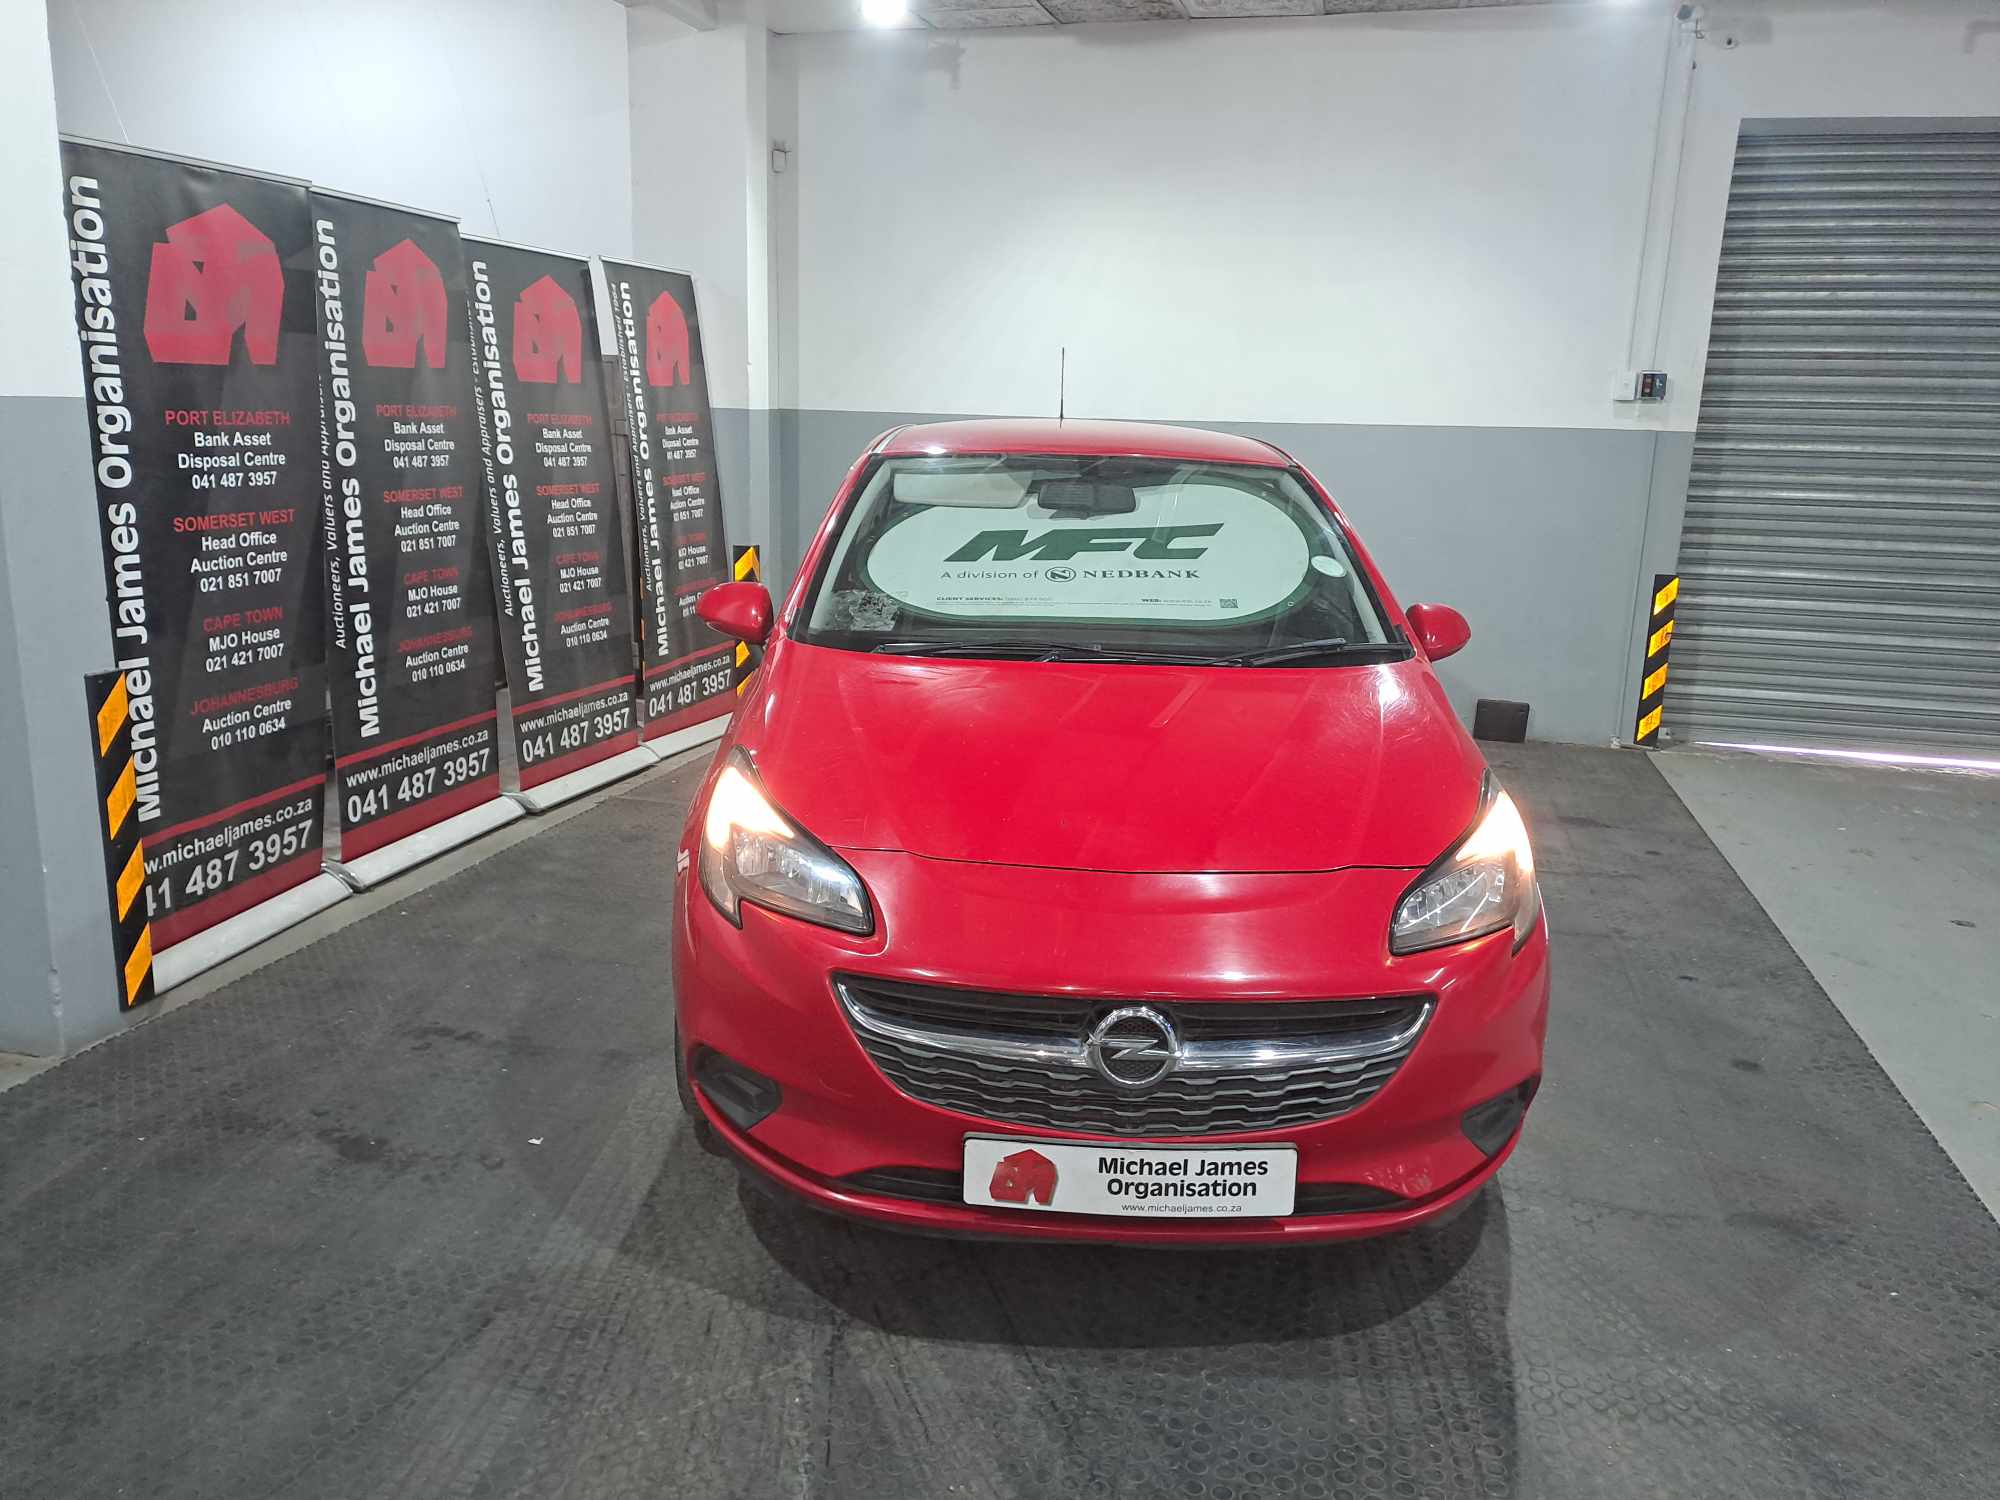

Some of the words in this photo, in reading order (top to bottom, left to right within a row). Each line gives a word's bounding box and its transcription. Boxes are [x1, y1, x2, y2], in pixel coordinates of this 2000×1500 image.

[69, 175, 132, 489] Organisation
[316, 218, 357, 467] Organisation
[472, 261, 514, 465] Organisation
[620, 282, 650, 460] Organisation
[165, 410, 208, 425] PORT
[213, 411, 290, 425] ELIZABETH
[393, 421, 418, 434] Bank
[420, 422, 445, 434] Asset
[474, 386, 492, 456] Appraisers
[194, 432, 230, 447] Bank
[233, 432, 272, 446] Asset
[384, 439, 425, 454] Disposal
[427, 438, 455, 450] Centre
[178, 452, 240, 470] Disposal
[244, 451, 286, 466] Centre
[393, 456, 409, 468] 041
[411, 455, 428, 468] 487
[430, 454, 449, 467] 3957
[483, 457, 495, 484] and
[192, 474, 217, 489] 041
[220, 473, 243, 487] 487
[248, 471, 277, 486] 3957
[401, 506, 424, 519] Head
[426, 504, 452, 517] Office
[489, 487, 502, 534] Valuers
[571, 498, 591, 508] Office
[643, 468, 659, 551] James
[174, 512, 256, 532] SOMERSET
[260, 509, 295, 525] WEST
[324, 494, 338, 551] Valuers
[341, 477, 369, 593] James
[394, 523, 430, 536] Auction
[432, 520, 460, 532] Centre
[503, 474, 528, 570] James
[202, 534, 235, 551] Head
[239, 532, 277, 547] Office
[401, 540, 416, 552] 021
[418, 537, 434, 550] 851
[437, 535, 456, 548] 7007
[943, 522, 1225, 562] MFC
[108, 502, 147, 645] James
[191, 555, 243, 573] Auction
[247, 550, 288, 566] Centre
[497, 539, 514, 616] Auctioneers,
[941, 570, 952, 579] A
[957, 569, 1017, 579] division
[1023, 569, 1037, 579] of
[1084, 568, 1200, 579] NEDBANK
[200, 577, 223, 592] 021
[228, 572, 249, 588] 851
[253, 568, 282, 585] 7007
[407, 587, 428, 602] MJO
[430, 584, 458, 597] House
[203, 613, 241, 632] CAPE
[244, 606, 283, 624] TOWN
[331, 556, 346, 649] Auctioneers,
[406, 605, 421, 618] 021
[424, 601, 439, 614] 421
[442, 597, 461, 611] 7007
[652, 558, 669, 656] Michael
[209, 633, 237, 652] MJO
[242, 627, 280, 645] House
[514, 578, 544, 692] Michael
[206, 656, 228, 672] 021
[231, 650, 253, 667] 421
[257, 643, 284, 661] 7007
[350, 602, 380, 739] Michael
[406, 651, 439, 668] Auction
[441, 645, 469, 658] Centre
[412, 668, 427, 682] 010
[429, 664, 444, 677] 110
[446, 658, 465, 673] 0634
[649, 655, 730, 692] www.michaeljames.co.za
[649, 690, 672, 717] 041
[677, 681, 697, 705] 487
[702, 669, 731, 696] 3957
[202, 710, 250, 733] Auction
[254, 698, 292, 718] Centre
[520, 691, 628, 733] www.michaeljames.co.za
[118, 657, 161, 823] Michael
[211, 732, 232, 750] 010
[235, 724, 256, 742] 110
[259, 717, 286, 736] 0634
[522, 732, 554, 763] 041
[560, 721, 589, 749] 487
[594, 707, 630, 738] 3957
[346, 729, 489, 788] www.michaeljames.co.za
[347, 784, 389, 823] 041
[398, 767, 436, 801] 487
[443, 748, 490, 786] 3957
[144, 798, 313, 875] w.michaeljames.co.za
[185, 850, 239, 896] 487
[249, 819, 313, 871] 3957
[1098, 1157, 1188, 1176] Michael
[1195, 1159, 1268, 1176] James
[1107, 1178, 1257, 1199] Organisation
[1121, 1203, 1242, 1214] www.michaeljames.co.za
